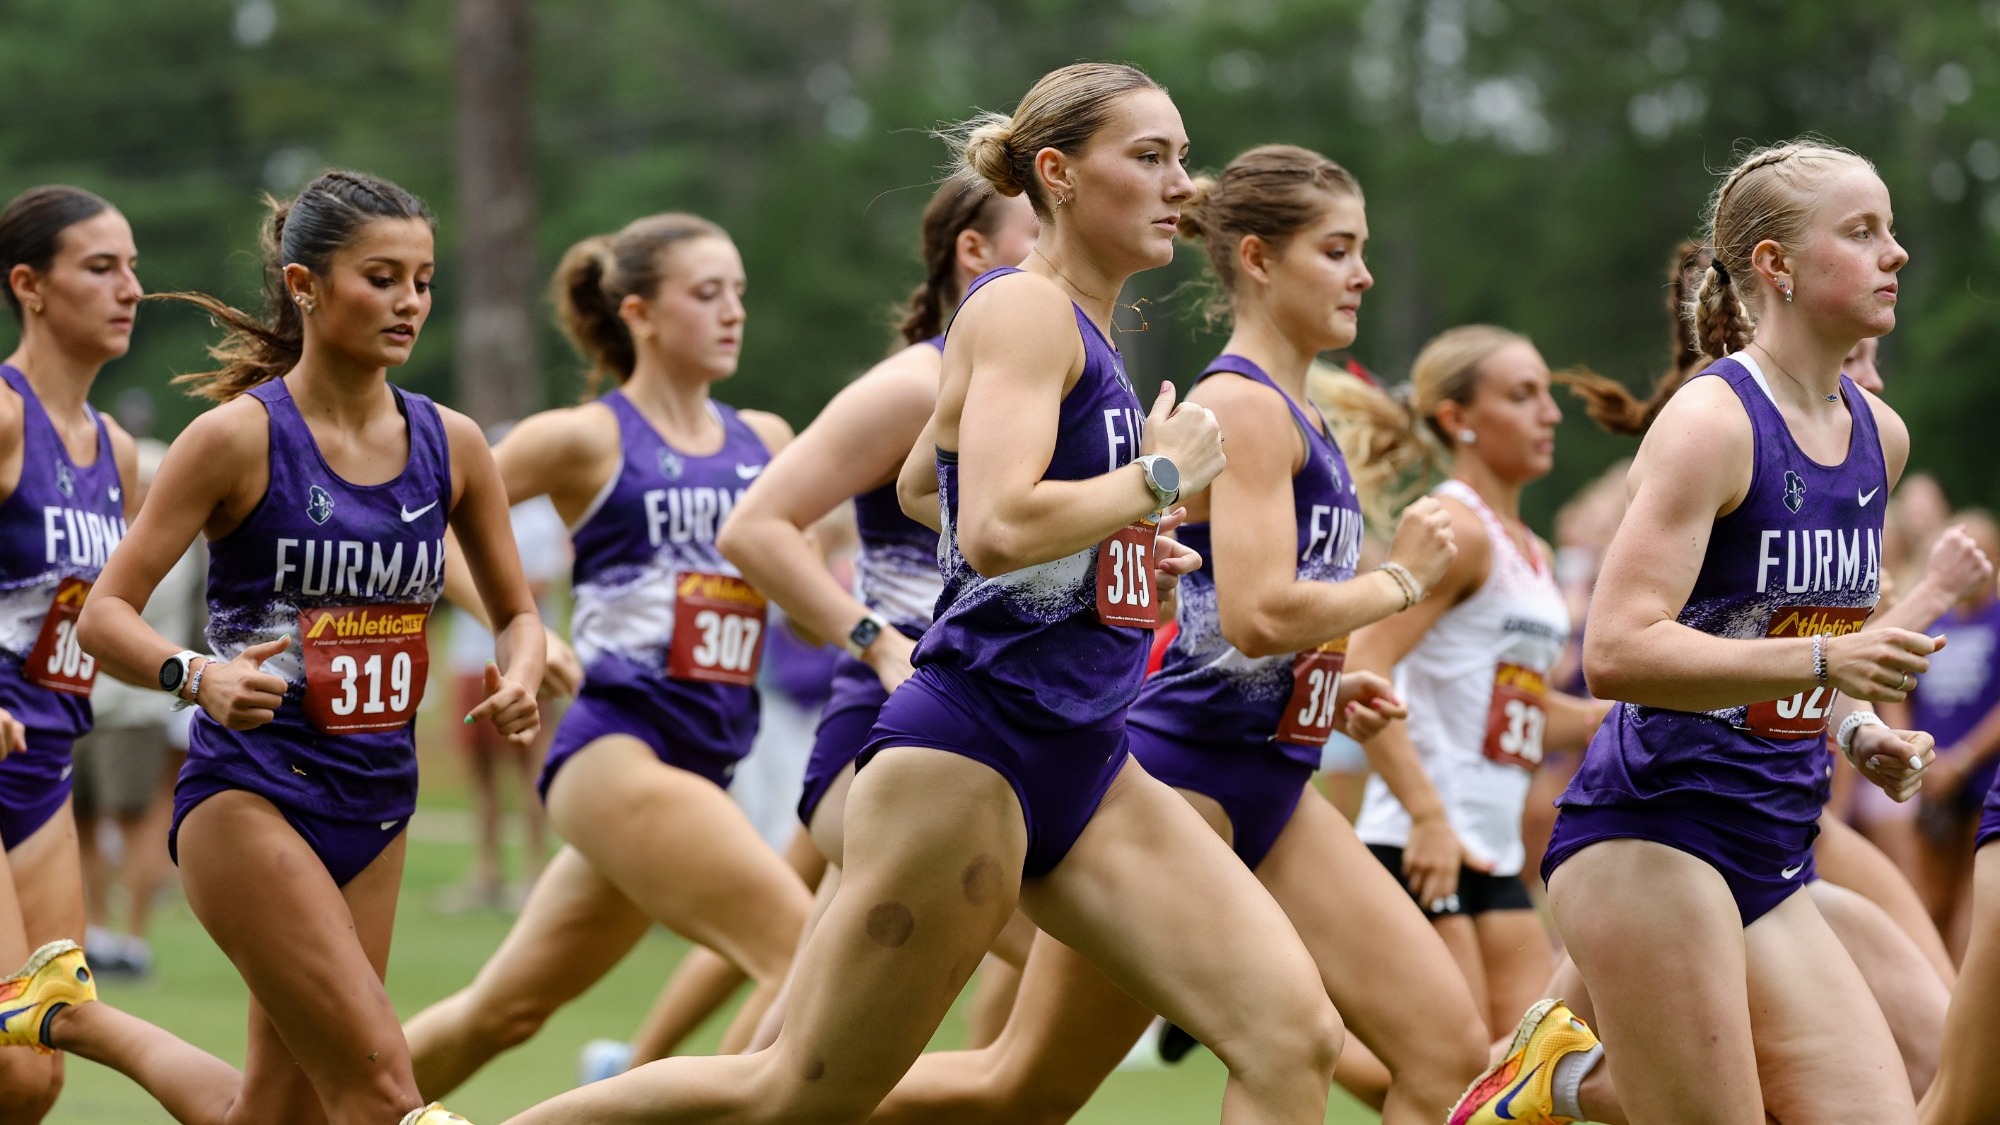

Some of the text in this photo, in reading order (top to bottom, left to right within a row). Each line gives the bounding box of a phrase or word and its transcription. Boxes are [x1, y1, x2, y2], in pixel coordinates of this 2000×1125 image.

[1107, 540, 1150, 607] 315
[1756, 528, 1882, 593] FURMA
[692, 610, 761, 672] 307
[331, 651, 412, 715] 319
